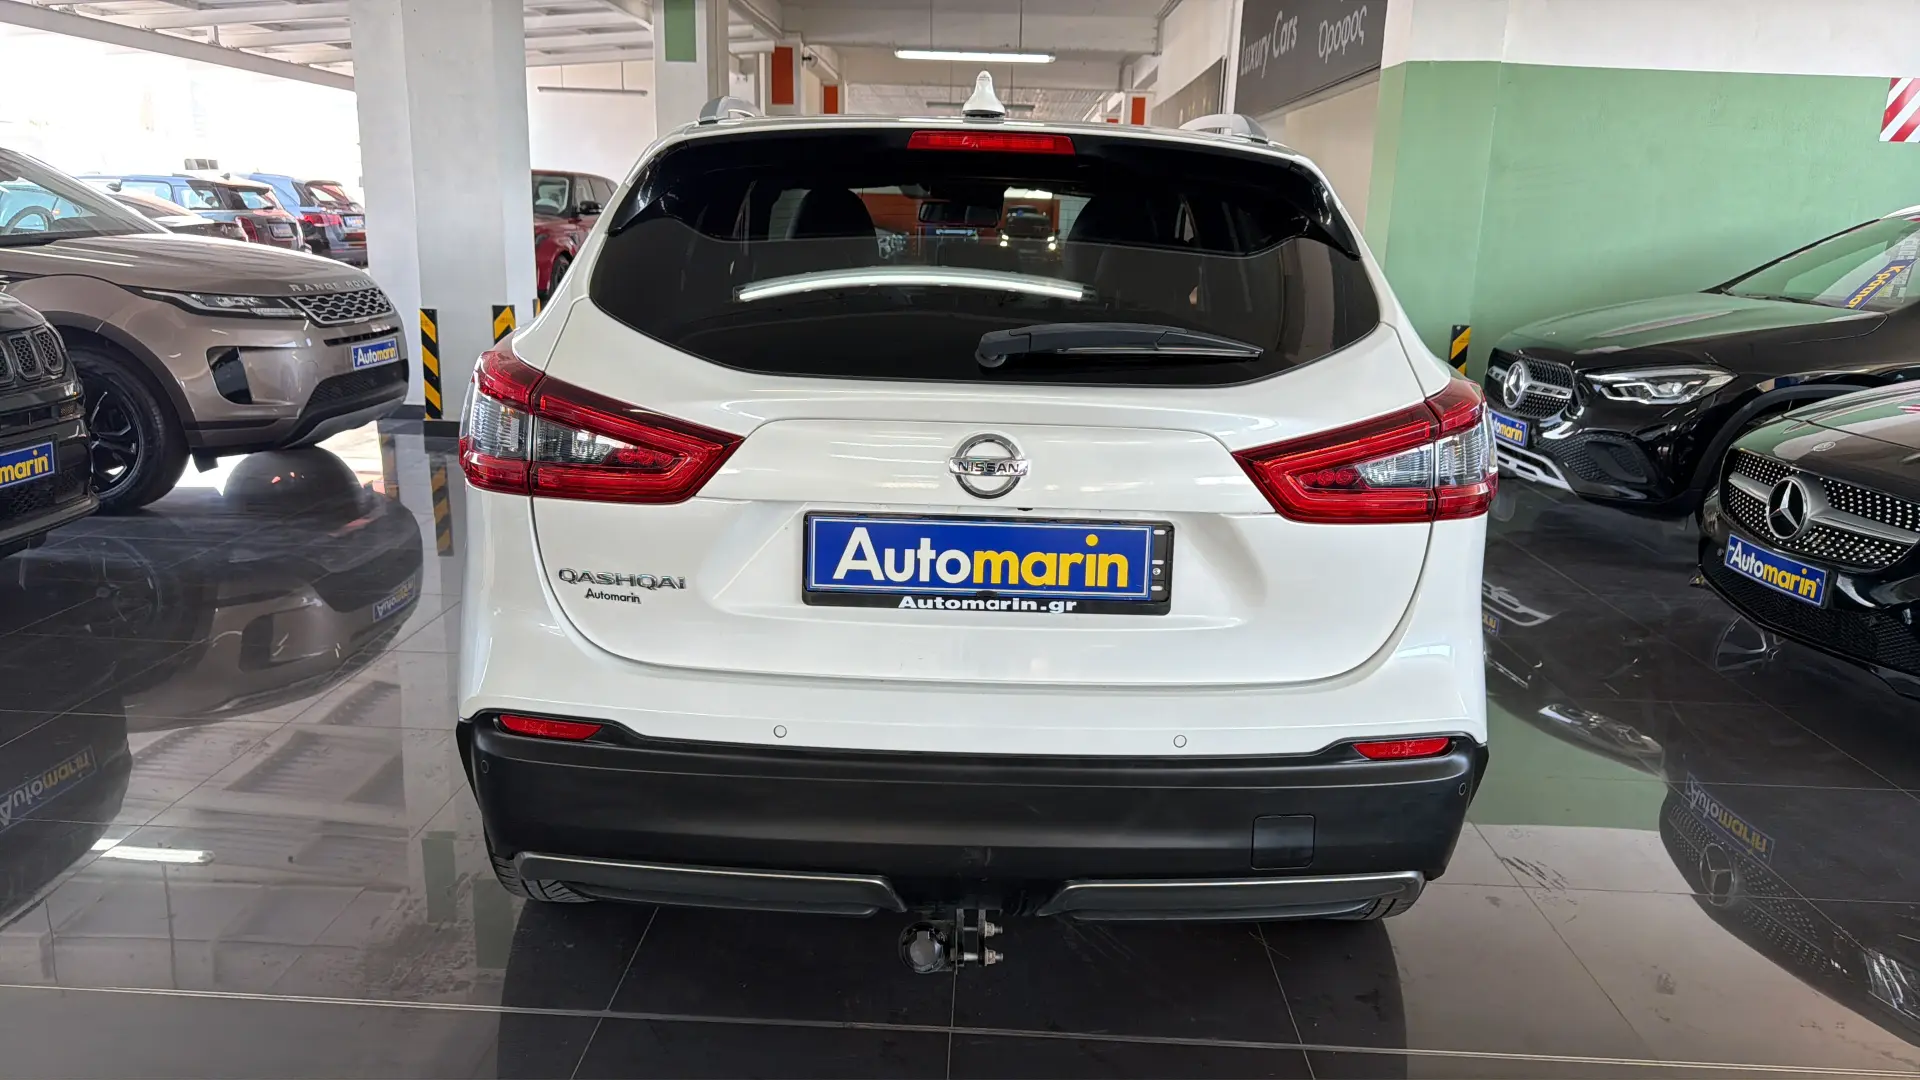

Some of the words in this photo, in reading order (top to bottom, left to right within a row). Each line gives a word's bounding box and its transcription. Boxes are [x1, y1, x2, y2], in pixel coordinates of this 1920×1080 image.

[1240, 33, 1272, 79] Luxury
[1272, 10, 1298, 59] Cars
[958, 461, 1020, 473] NISSAN
[832, 526, 1129, 588] Automarin
[558, 567, 686, 590] QASHQAI
[1730, 541, 1817, 599] Automarin
[584, 587, 641, 604] Automarin
[898, 597, 1077, 614] Automarin.gr
